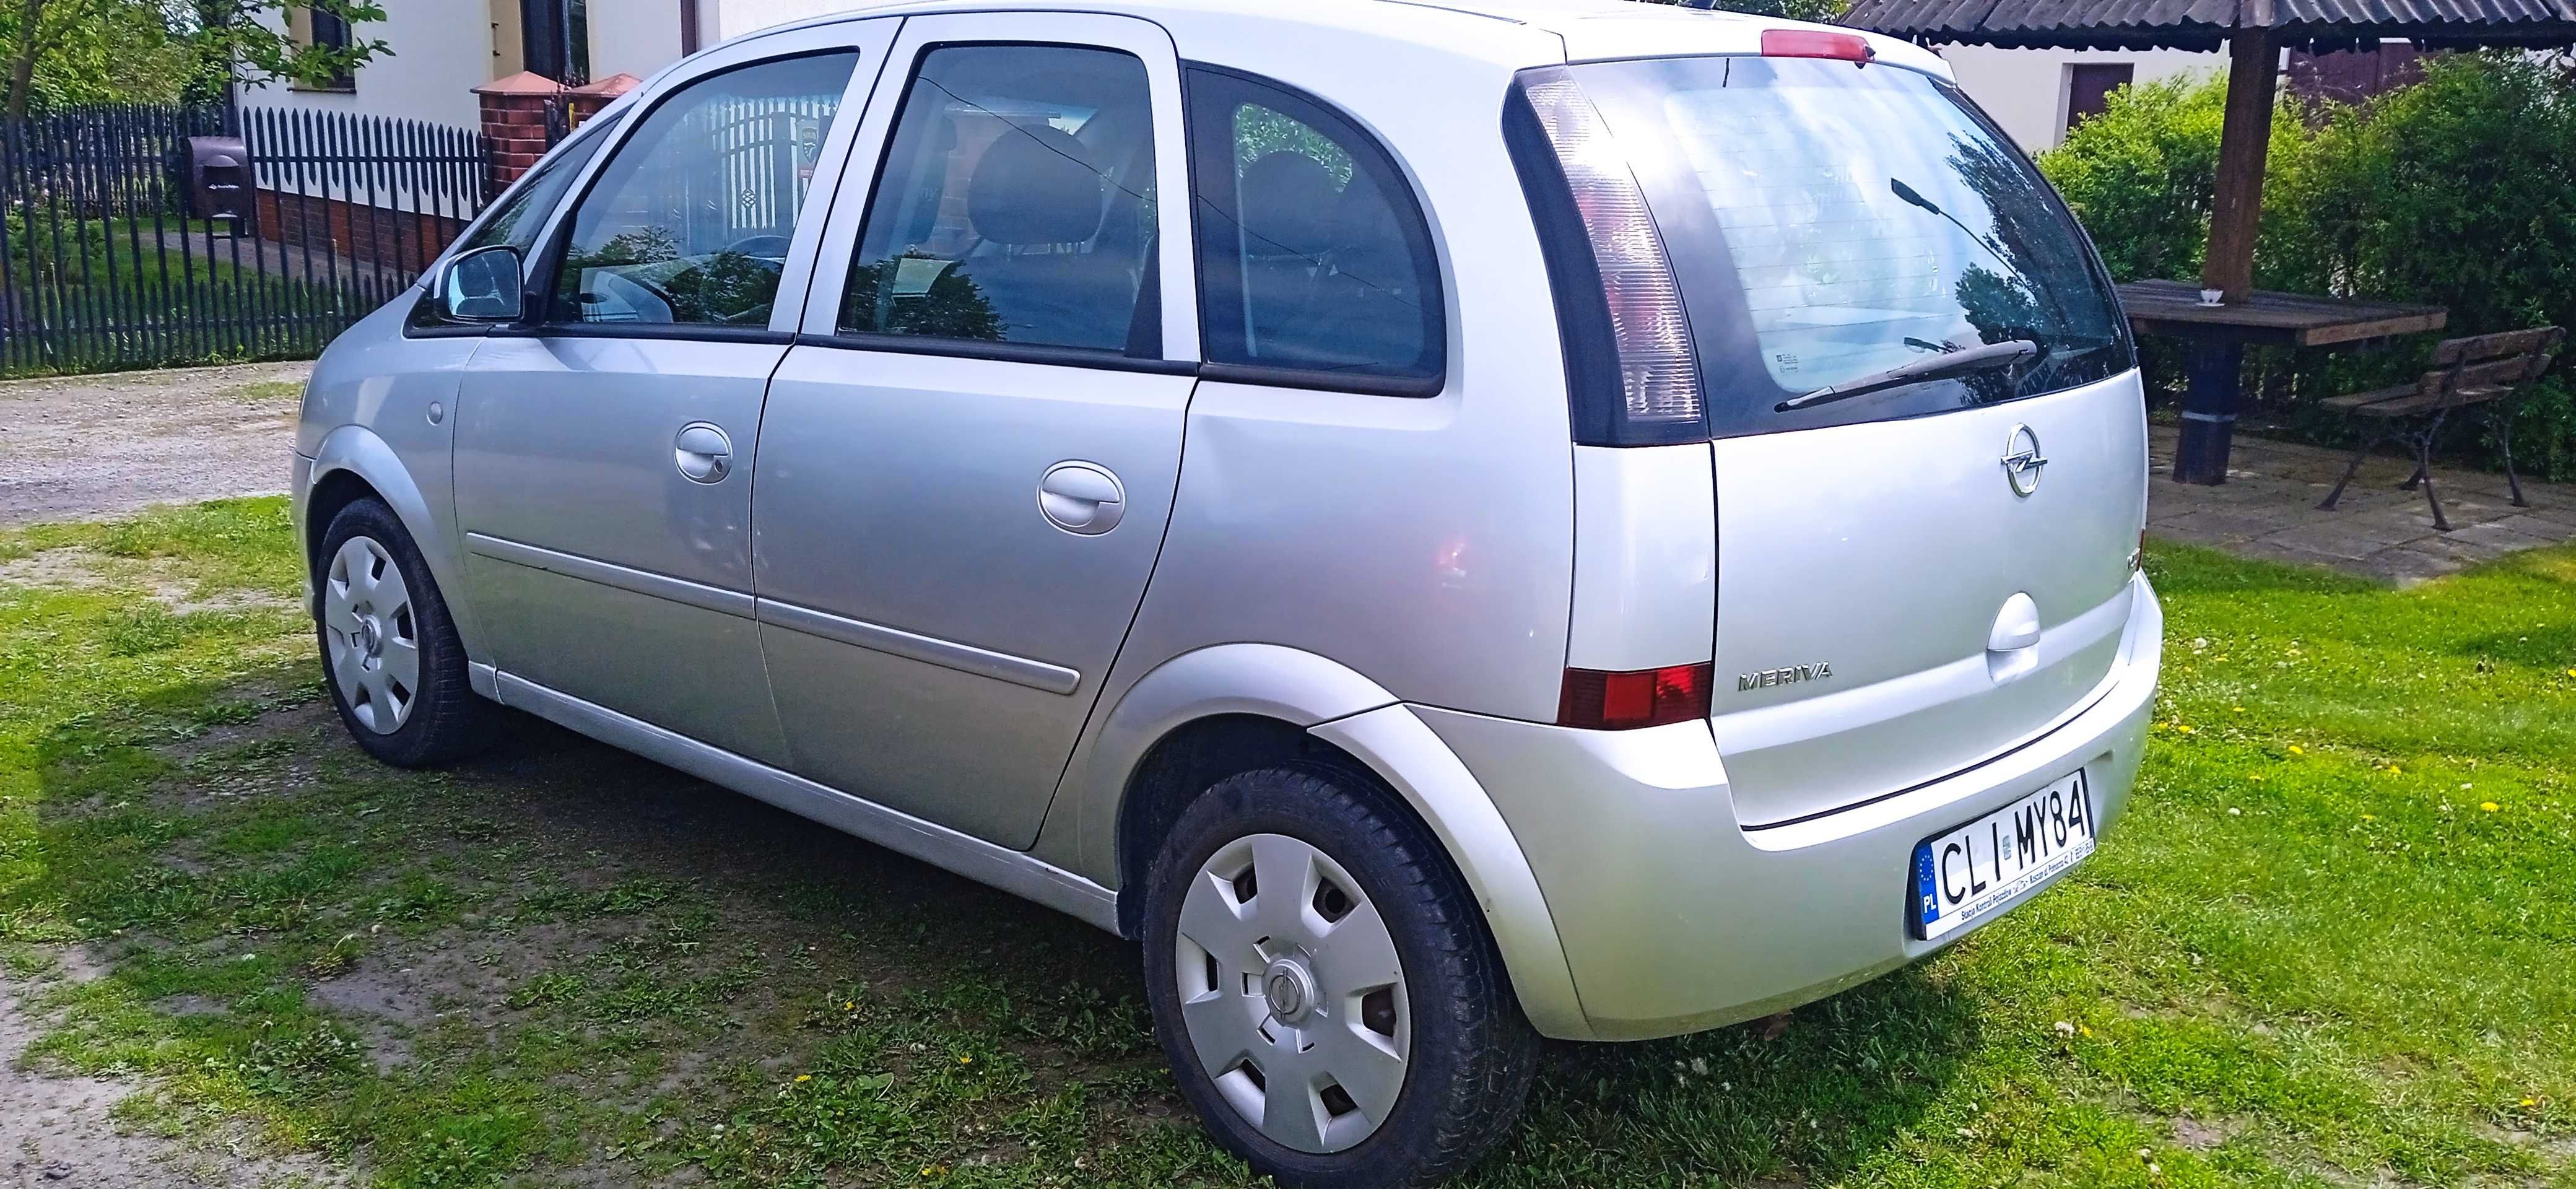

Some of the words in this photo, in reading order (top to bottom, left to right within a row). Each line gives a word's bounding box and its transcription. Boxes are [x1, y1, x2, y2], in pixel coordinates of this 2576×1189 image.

[1738, 660, 1833, 692] MERIVA
[1942, 822, 2001, 905] CLI
[2014, 780, 2086, 871] MY84
[1923, 895, 1937, 913] PL
